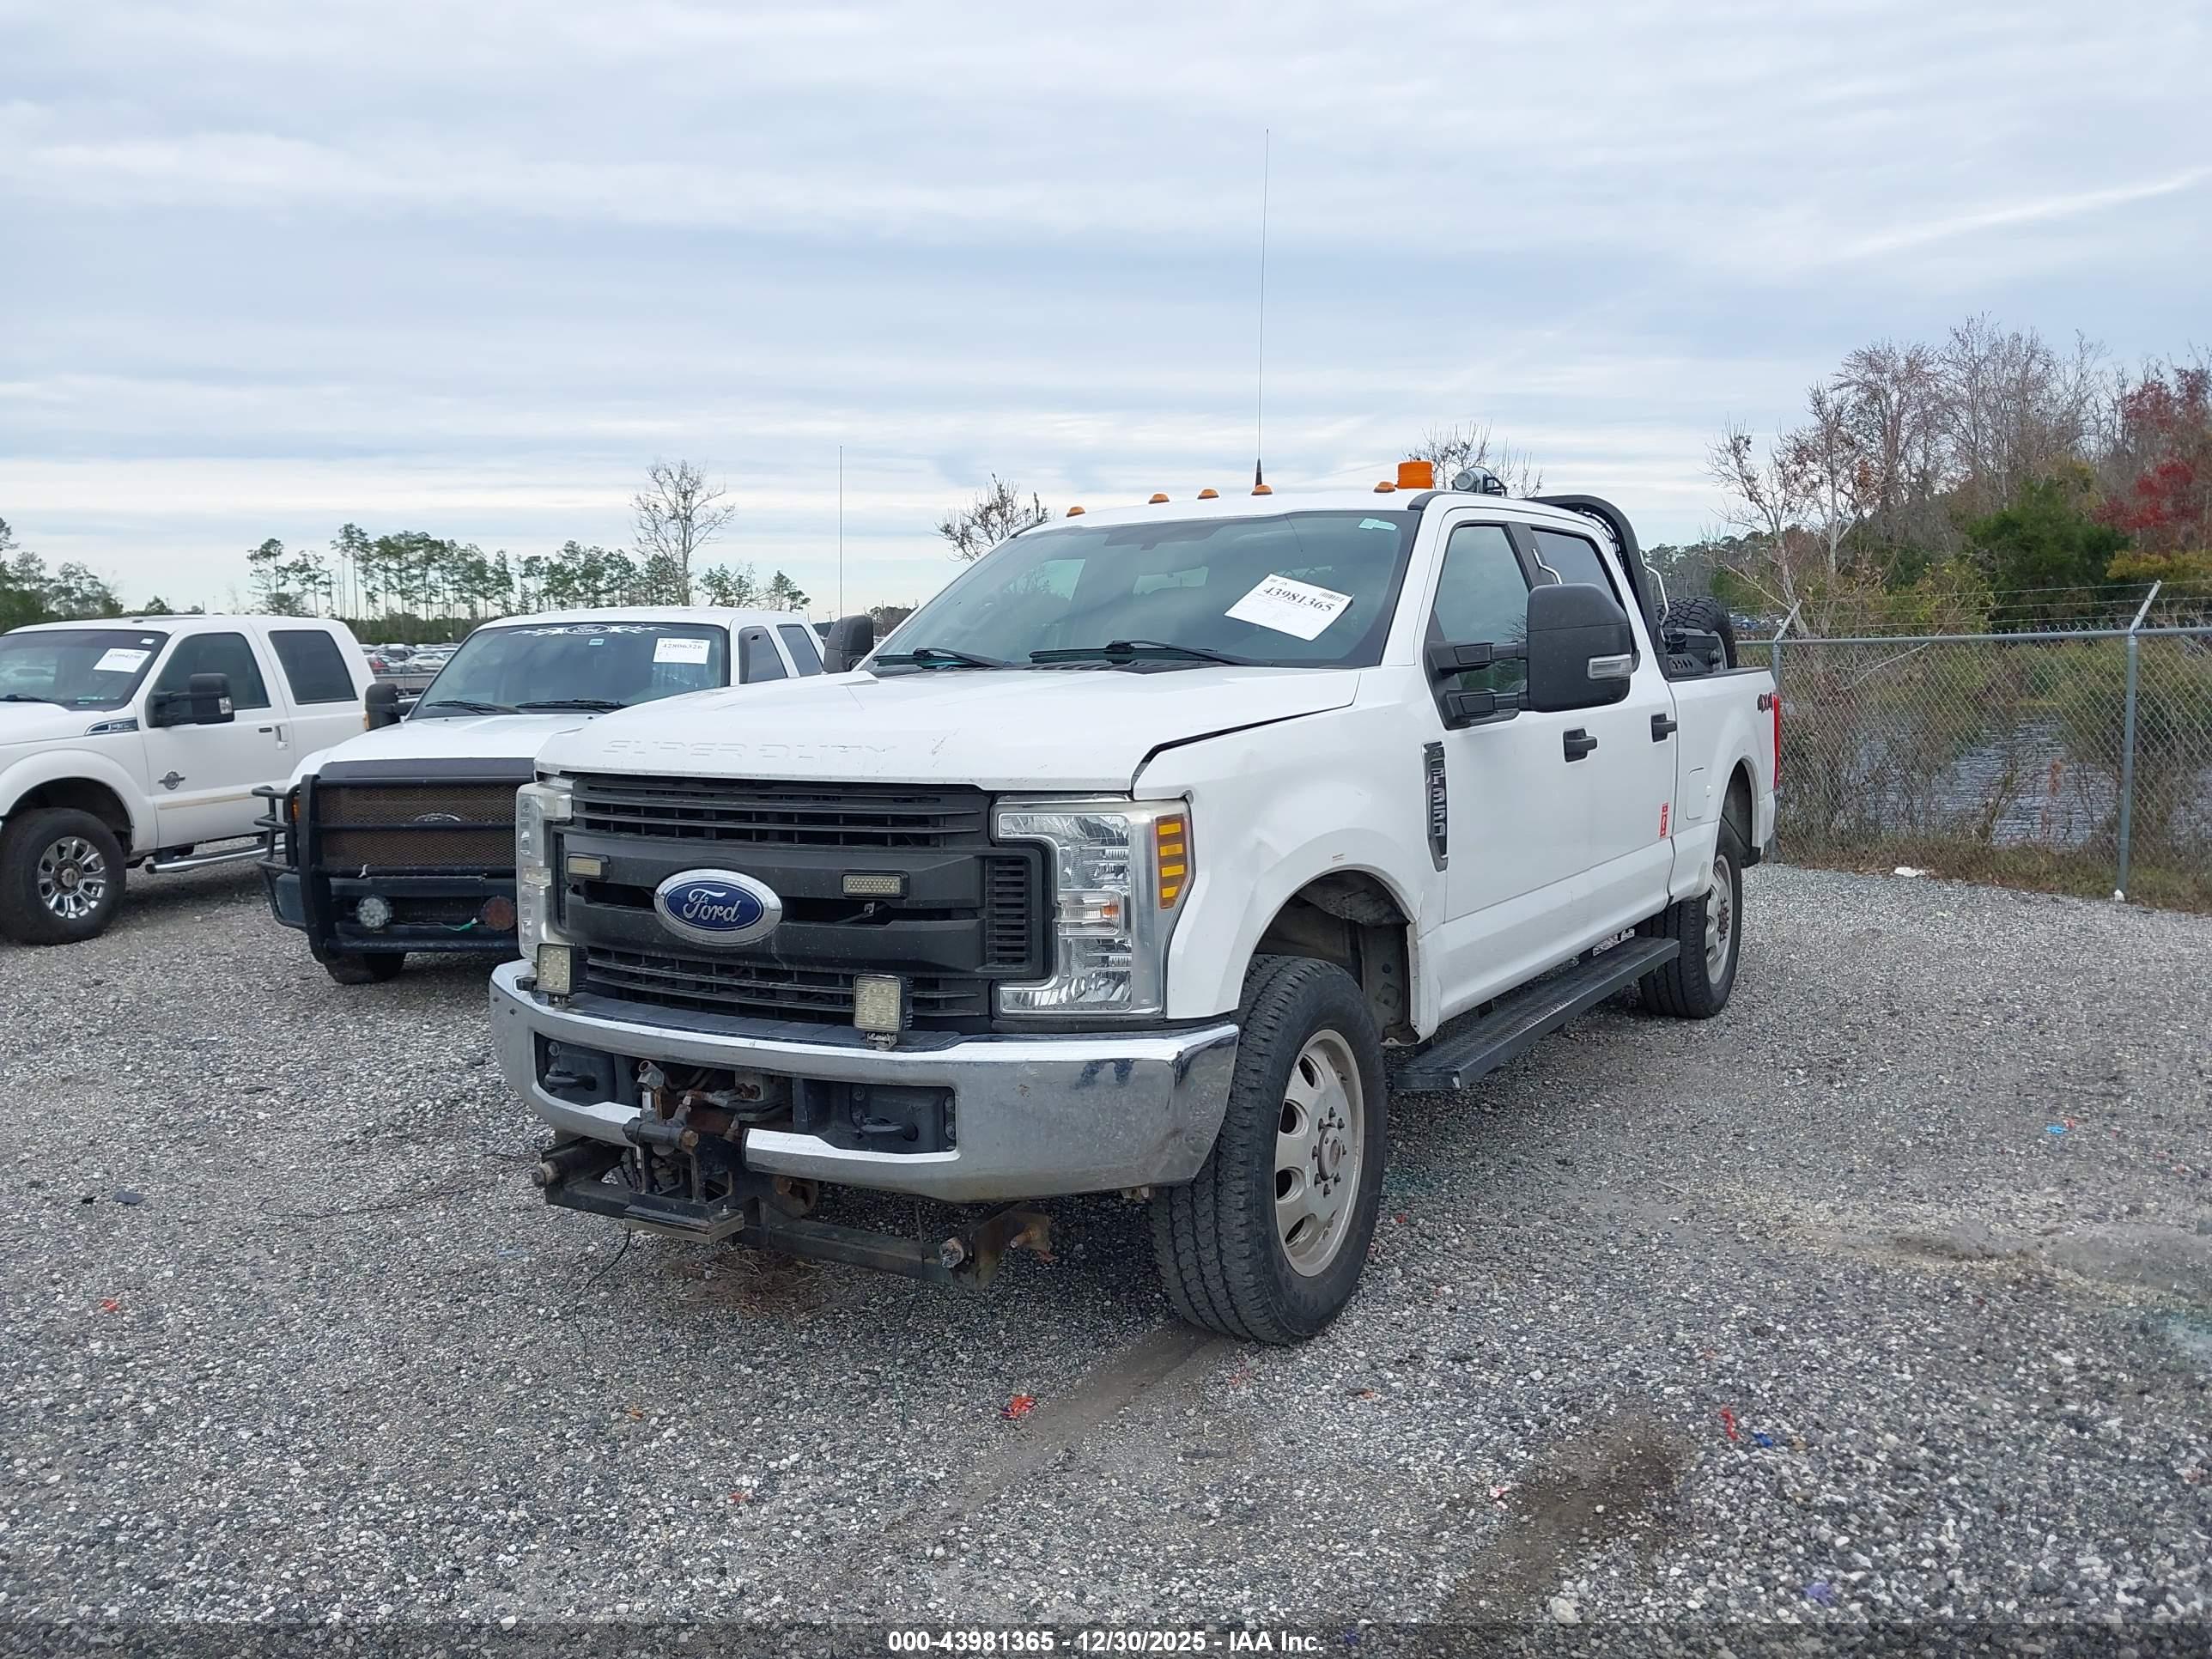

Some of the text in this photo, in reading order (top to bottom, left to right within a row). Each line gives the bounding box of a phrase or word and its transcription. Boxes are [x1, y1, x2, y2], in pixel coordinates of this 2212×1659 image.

[1263, 586, 1336, 612] 43981365
[602, 740, 746, 757] SUPER
[683, 887, 741, 923] Ford
